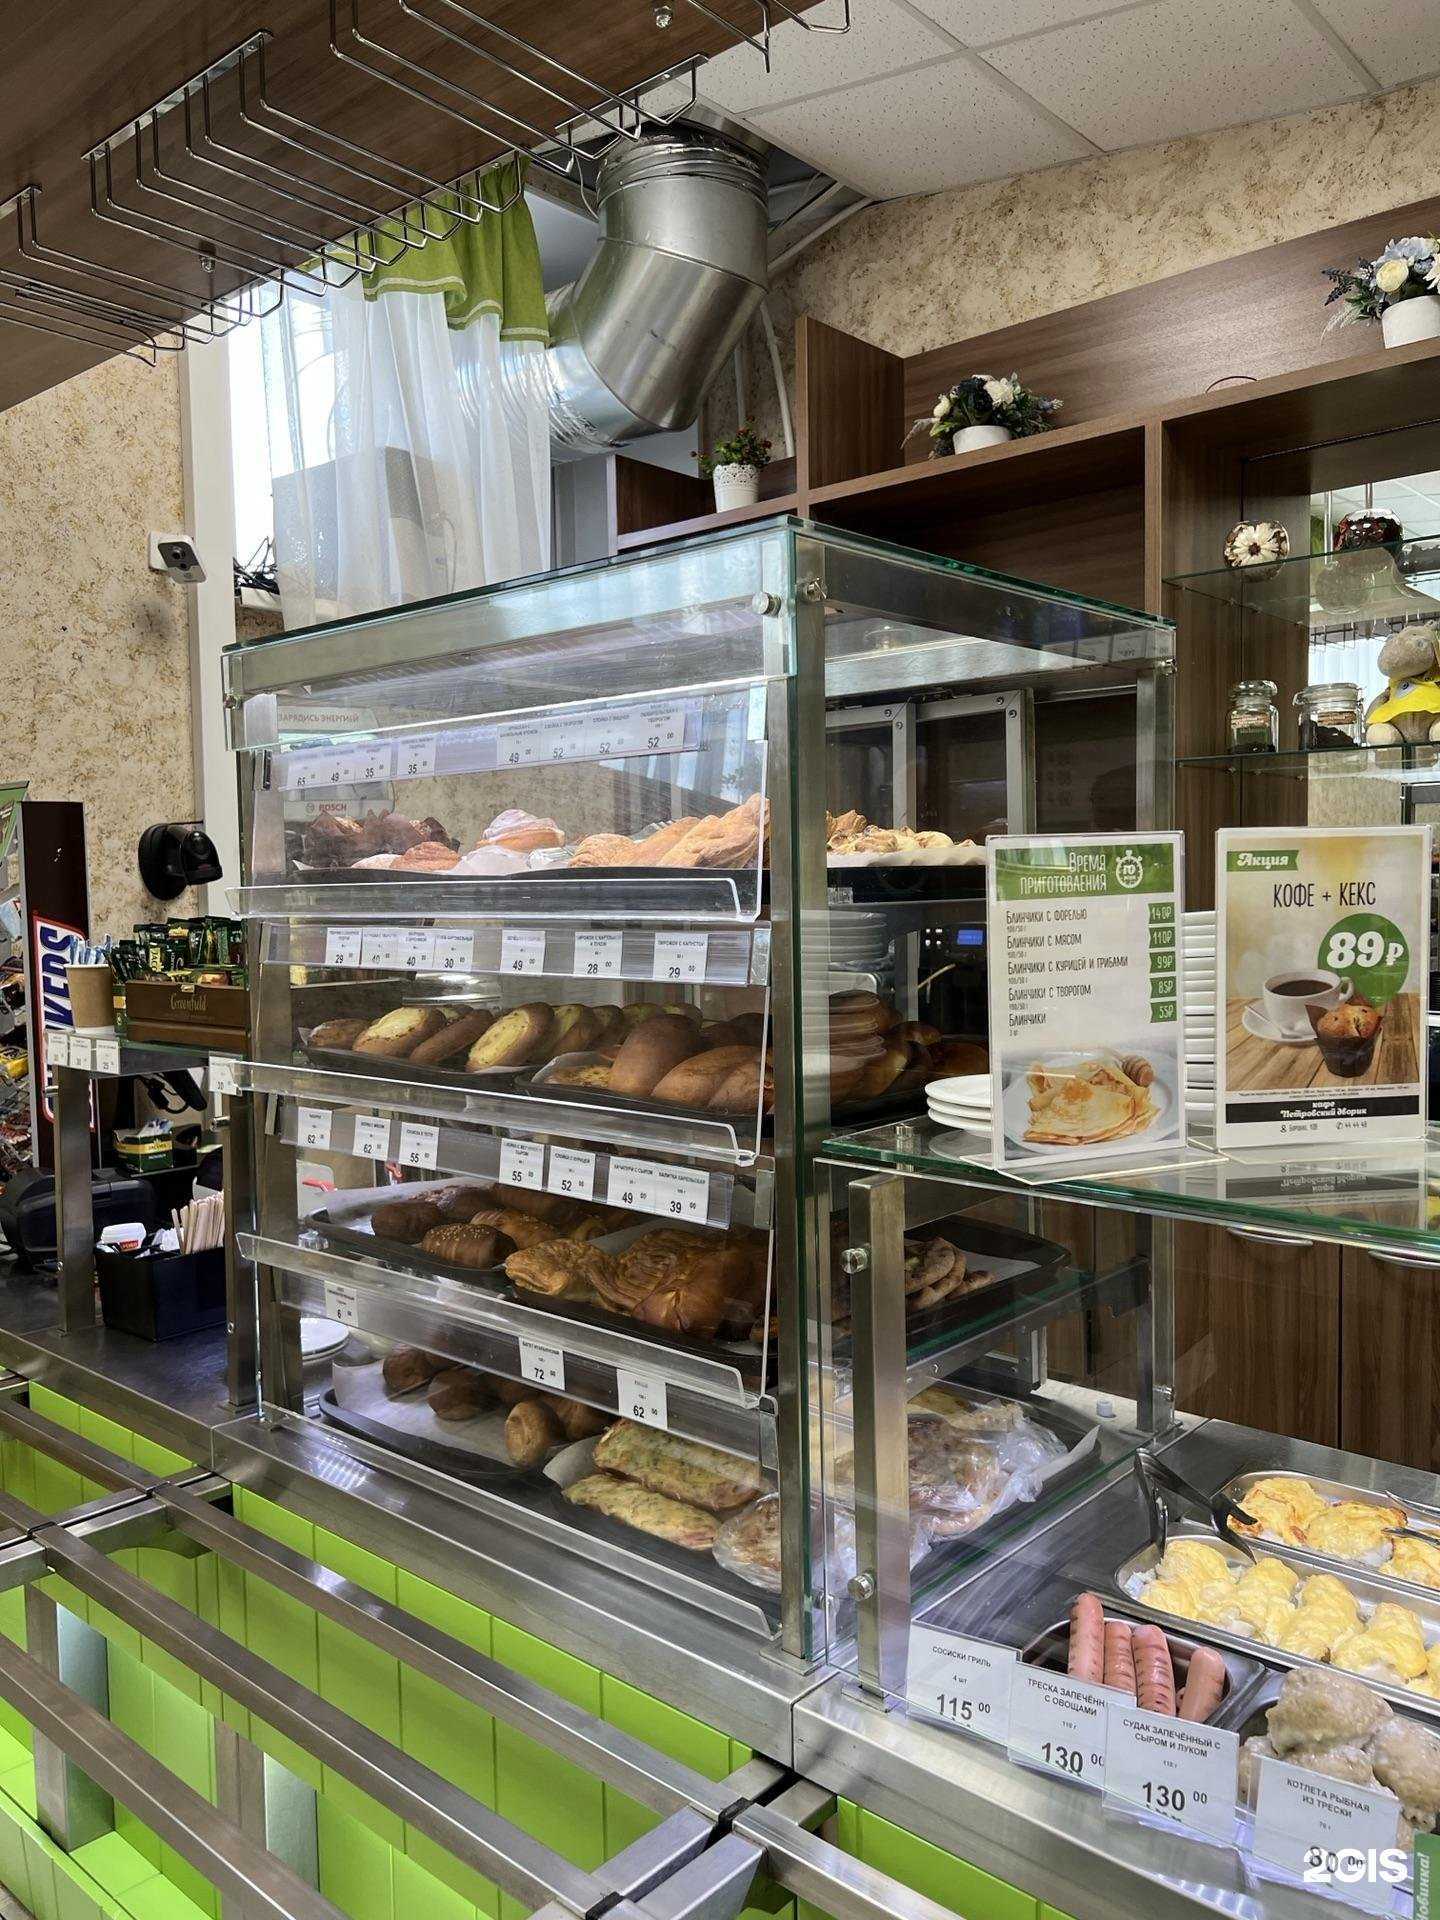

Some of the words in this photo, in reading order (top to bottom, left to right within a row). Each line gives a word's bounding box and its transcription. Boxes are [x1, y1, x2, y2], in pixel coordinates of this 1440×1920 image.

[648, 736, 660, 749] 52
[509, 752, 520, 763] 49
[408, 764, 418, 775] 35
[319, 804, 347, 812] BOSCH
[1069, 852, 1106, 873] ВРЕМЯ
[1237, 852, 1290, 870] Акция
[1020, 873, 1107, 895] ПРИГОТОВЛЕНИЯ
[1273, 883, 1315, 908] КОФЕ
[1322, 891, 1332, 902] +
[1339, 881, 1376, 906] КЕКС
[1046, 911, 1051, 922] С
[1053, 908, 1088, 922] ФОРЕЛЬЮ
[1047, 936, 1051, 947] С
[1055, 933, 1082, 947] МЯСОМ
[406, 956, 416, 967] 40
[444, 958, 454, 968] 30
[512, 960, 523, 971] 49
[1048, 962, 1053, 972] С
[1056, 957, 1087, 972] КУРИЦЕЙ
[1089, 959, 1094, 969] И
[1097, 956, 1129, 969] ГРИБАМИ
[587, 963, 598, 975] 28
[668, 966, 681, 978] 29
[1049, 987, 1054, 998] С
[1056, 984, 1092, 997] ТВОРОГОМ
[1312, 1101, 1335, 1109] кафе
[1280, 1108, 1336, 1119] Петровский
[1337, 1107, 1367, 1117] дворик
[363, 1143, 373, 1154] 62
[409, 1152, 419, 1164] 55
[512, 1170, 522, 1182] 55
[561, 1179, 572, 1191] 52
[622, 1191, 634, 1204] 49
[669, 1200, 682, 1214] 39
[534, 1367, 545, 1380] 72
[633, 1405, 645, 1419] 62
[932, 1645, 966, 1661] СОСИСКИ
[966, 1653, 992, 1668] ГРИЛЬ
[958, 1677, 967, 1685] шт
[1027, 1678, 1058, 1695] ТРЕСКА
[1060, 1688, 1105, 1707] ЗАПЕЧЁНН
[936, 1693, 973, 1721] 115
[978, 1702, 991, 1714] 00
[1044, 1694, 1051, 1703] С
[1052, 1697, 1097, 1717] ОВОЩАМИ
[1122, 1718, 1151, 1732] СУДАК
[1152, 1725, 1213, 1749] ЗАПЕЧЁННЫЙ
[1214, 1741, 1221, 1750] С
[1134, 1732, 1168, 1747] СЫРОМ
[1169, 1742, 1176, 1750] И
[1177, 1744, 1208, 1758] ЛУКОМ
[1041, 1742, 1083, 1774] 130
[1142, 1781, 1186, 1812] 130
[1192, 1790, 1208, 1804] 00
[1286, 1778, 1328, 1799] КОТЛЕТА
[1329, 1792, 1370, 1813] РЫБНАЯ
[1302, 1795, 1314, 1805] ИЗ
[1317, 1800, 1352, 1818] ТРЕСКИ
